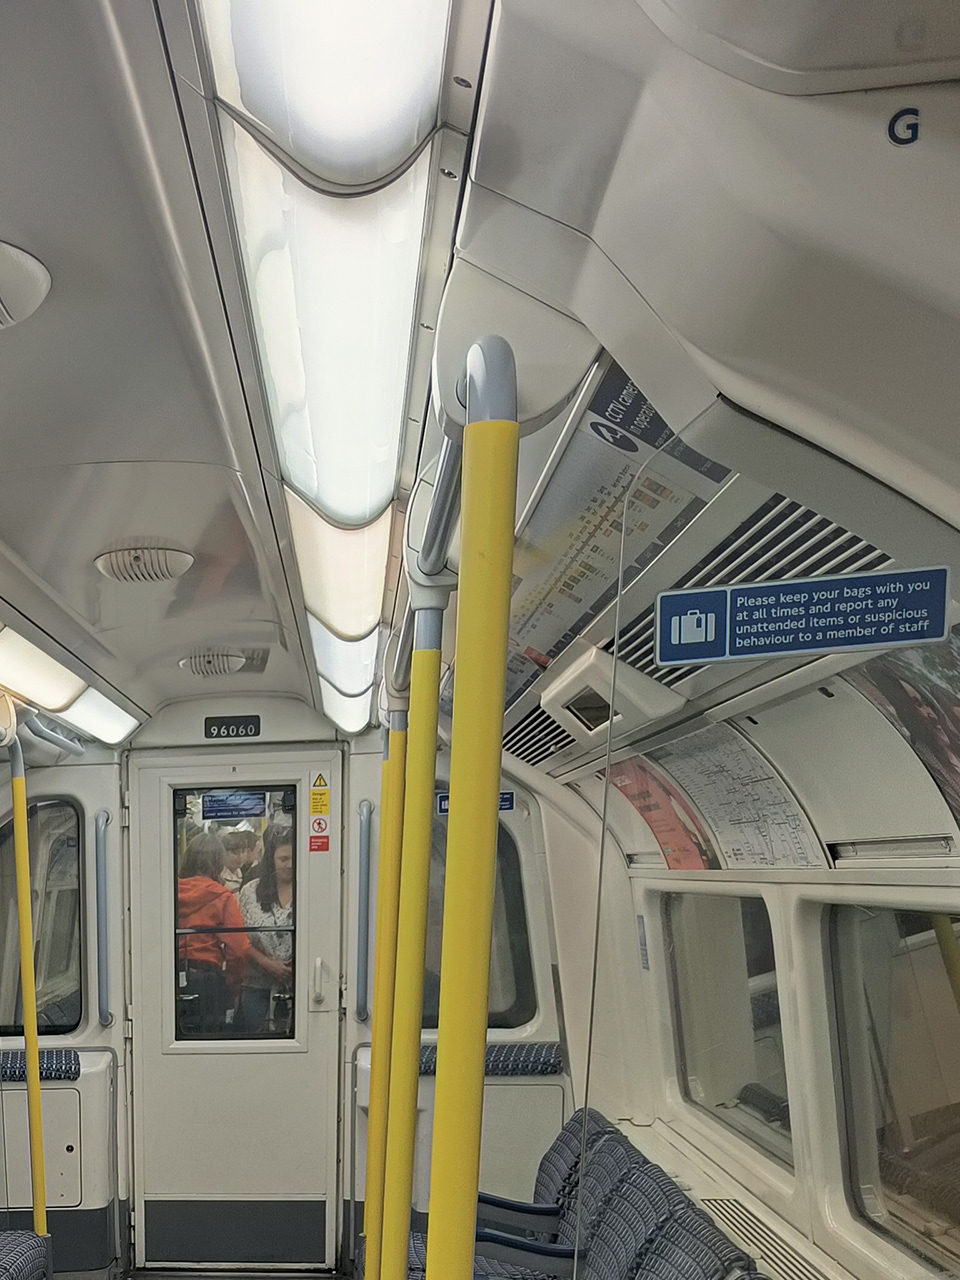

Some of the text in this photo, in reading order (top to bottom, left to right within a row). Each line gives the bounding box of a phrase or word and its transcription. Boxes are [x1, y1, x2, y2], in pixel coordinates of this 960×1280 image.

[888, 107, 919, 145] G
[605, 400, 627, 422] CCTV
[736, 580, 931, 608] Please keep your bags with you
[736, 597, 899, 621] at all times and report any
[736, 608, 928, 634] unattended items or suspicious
[736, 620, 930, 648] behaviour to a member of staff
[211, 724, 255, 737] 96060
